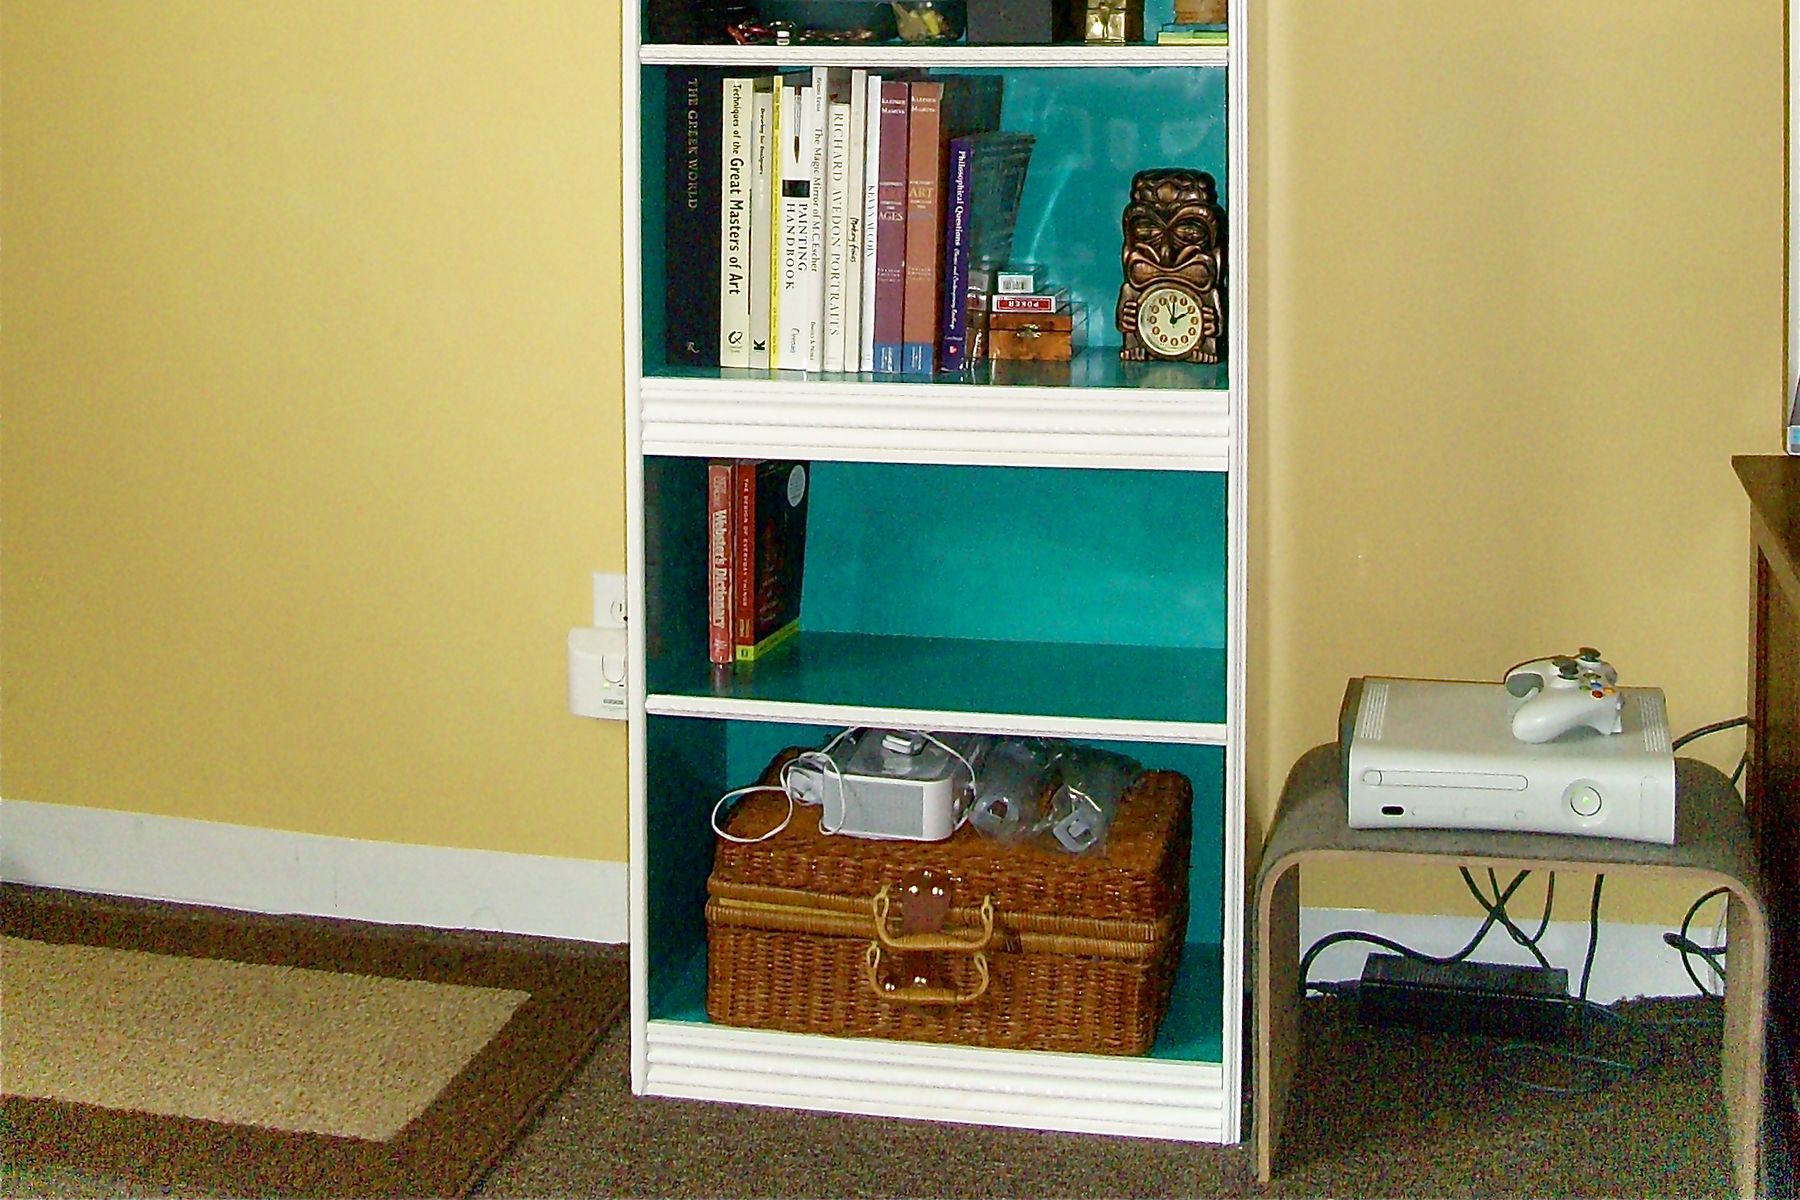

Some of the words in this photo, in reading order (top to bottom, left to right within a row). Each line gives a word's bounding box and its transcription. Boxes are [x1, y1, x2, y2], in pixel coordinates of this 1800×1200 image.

[687, 78, 699, 106] THE
[730, 83, 742, 127] Techniques
[687, 110, 699, 155] GREEK
[732, 142, 741, 155] the
[733, 130, 742, 139] of
[814, 128, 823, 144] The
[832, 112, 844, 182] RICHARD
[729, 158, 745, 195] Great
[812, 147, 823, 174] Magic
[955, 150, 966, 204] Philosophical
[687, 158, 699, 209] WORLD
[812, 177, 822, 206] Mirror
[909, 186, 934, 198] ART
[729, 199, 745, 251] Masters
[812, 209, 822, 218] of
[831, 190, 843, 247] AVEDON
[879, 211, 904, 222] AGES
[953, 205, 965, 246] Questions
[785, 203, 796, 291] HANDBOOK
[797, 203, 808, 272] PAINTING
[729, 256, 742, 270] of
[728, 273, 743, 295] Art
[829, 253, 841, 337] PORTRAITS
[713, 509, 728, 566] Webster's
[712, 567, 727, 629] Dictionary
